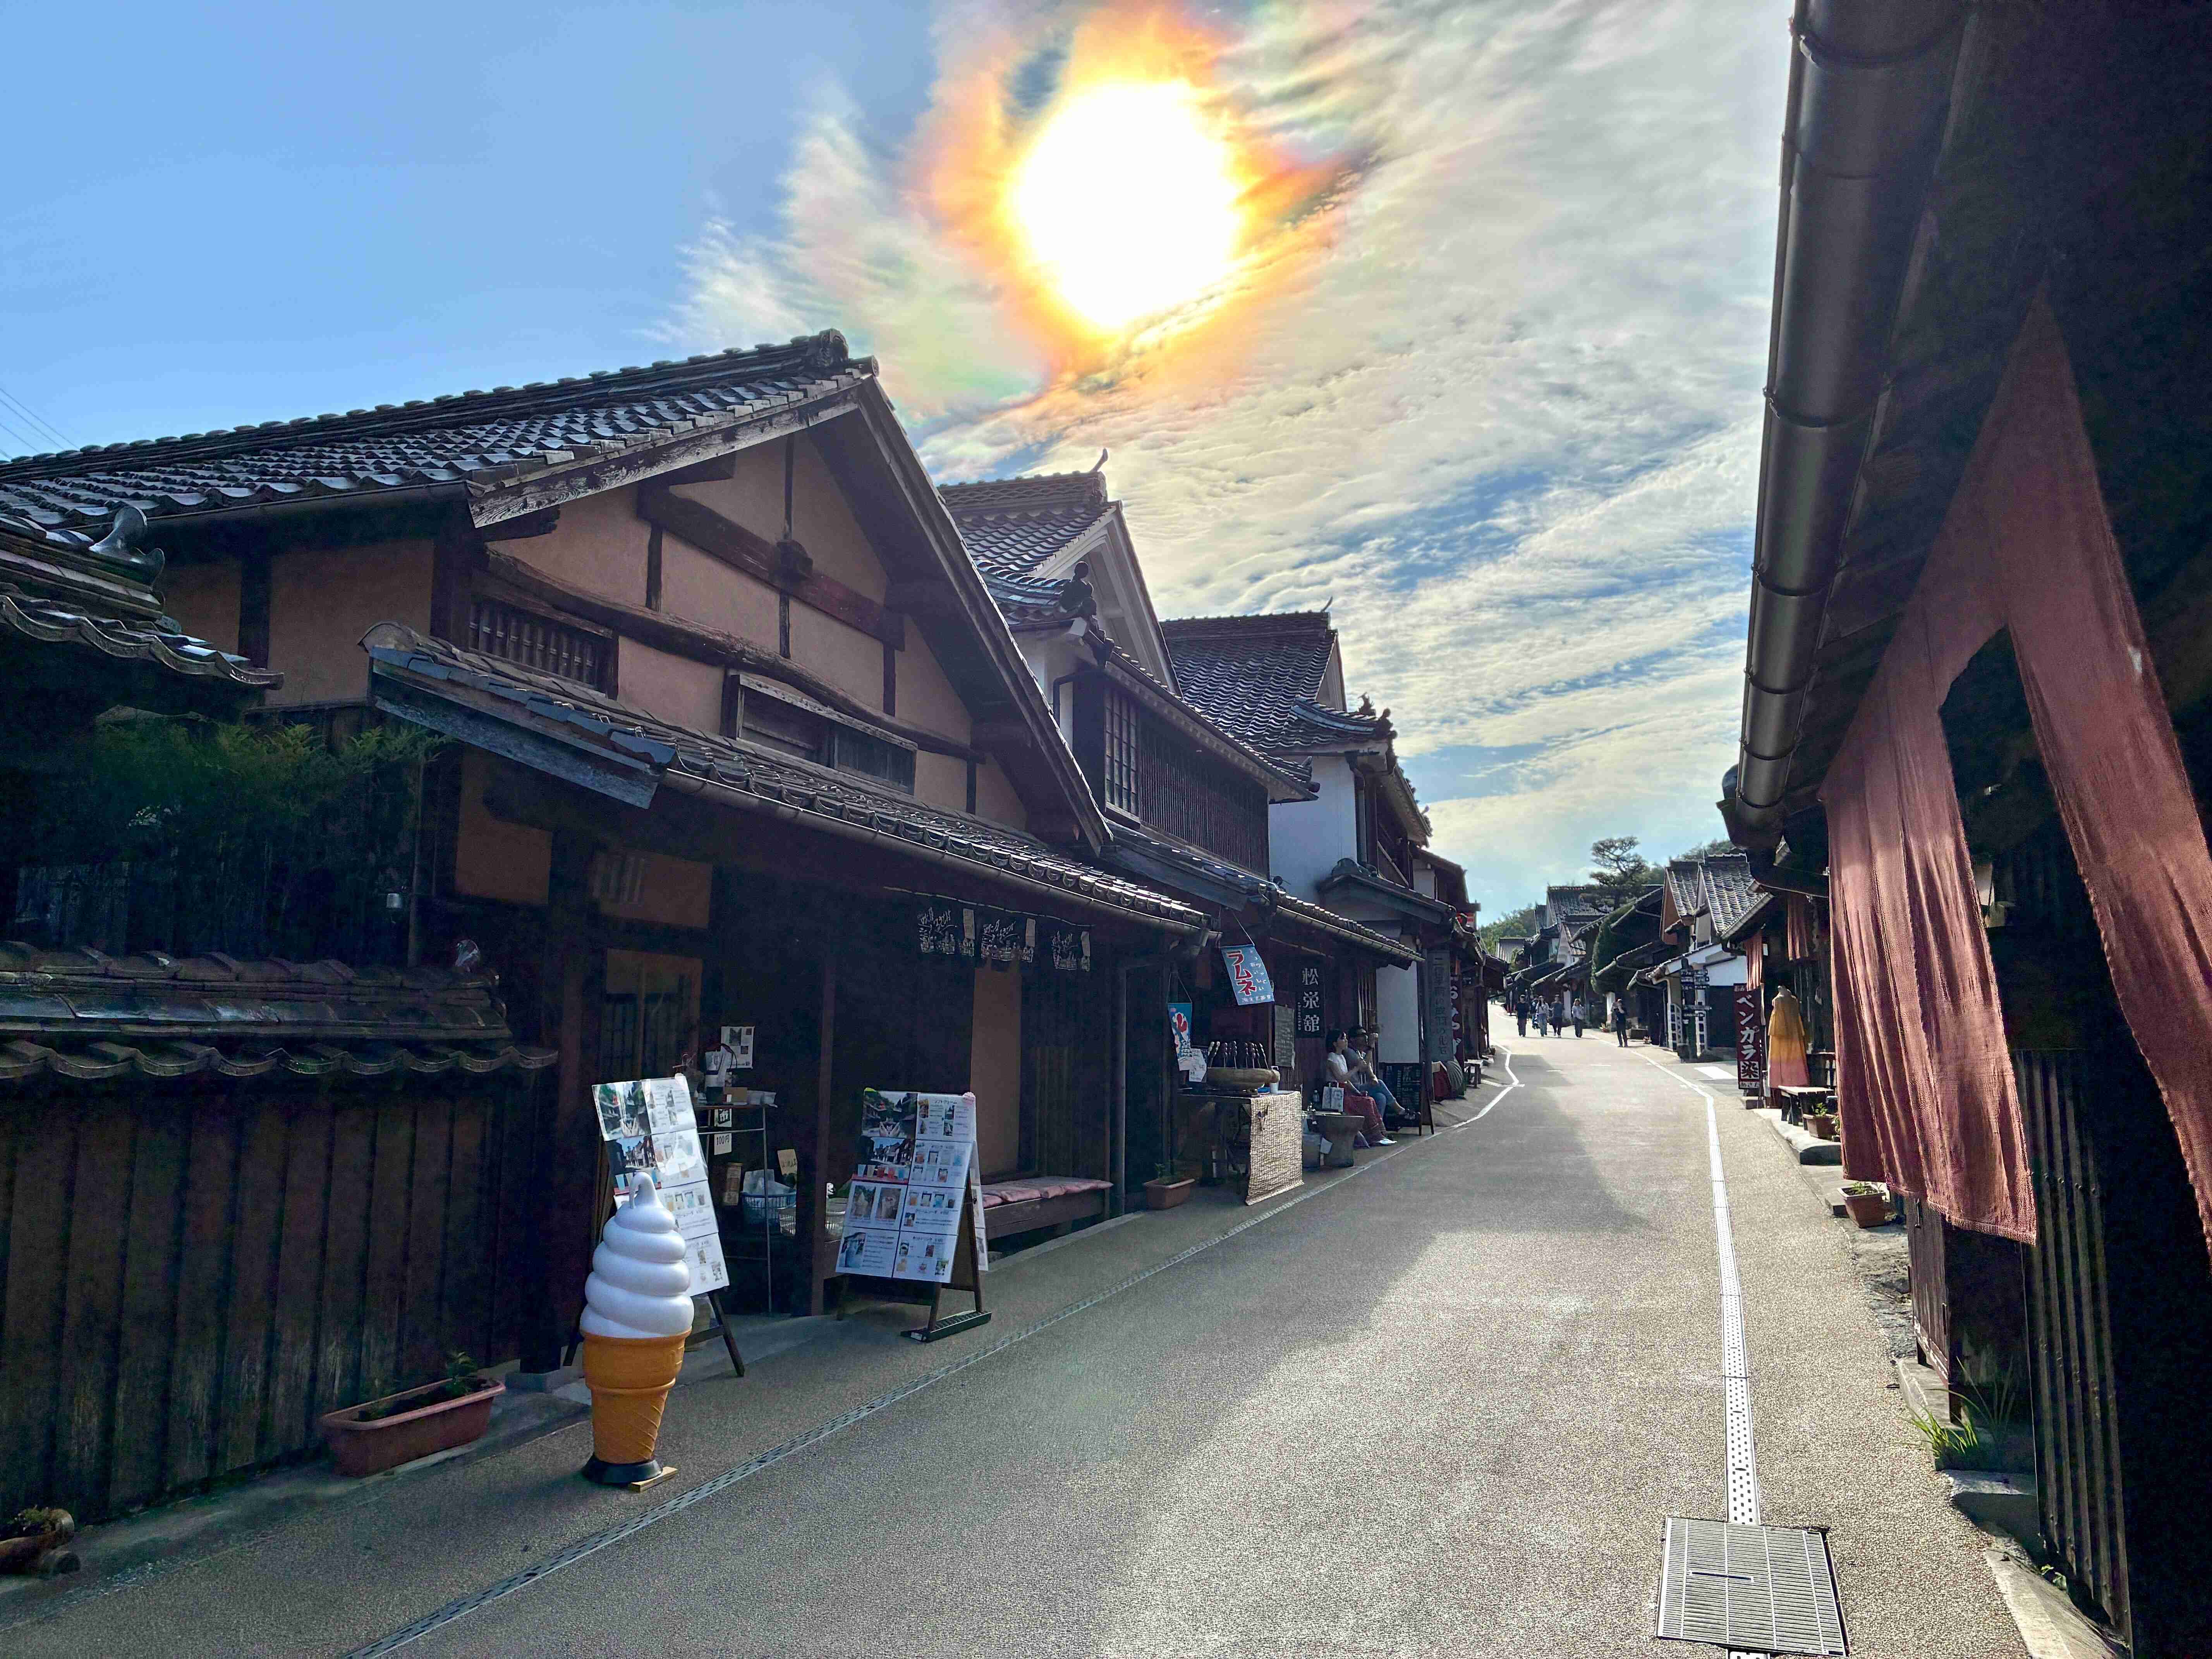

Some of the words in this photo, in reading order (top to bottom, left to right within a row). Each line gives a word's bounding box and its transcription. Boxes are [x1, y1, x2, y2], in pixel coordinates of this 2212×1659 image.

[1226, 950, 1257, 996] ラムネ
[1302, 967, 1320, 1032] 松栄館
